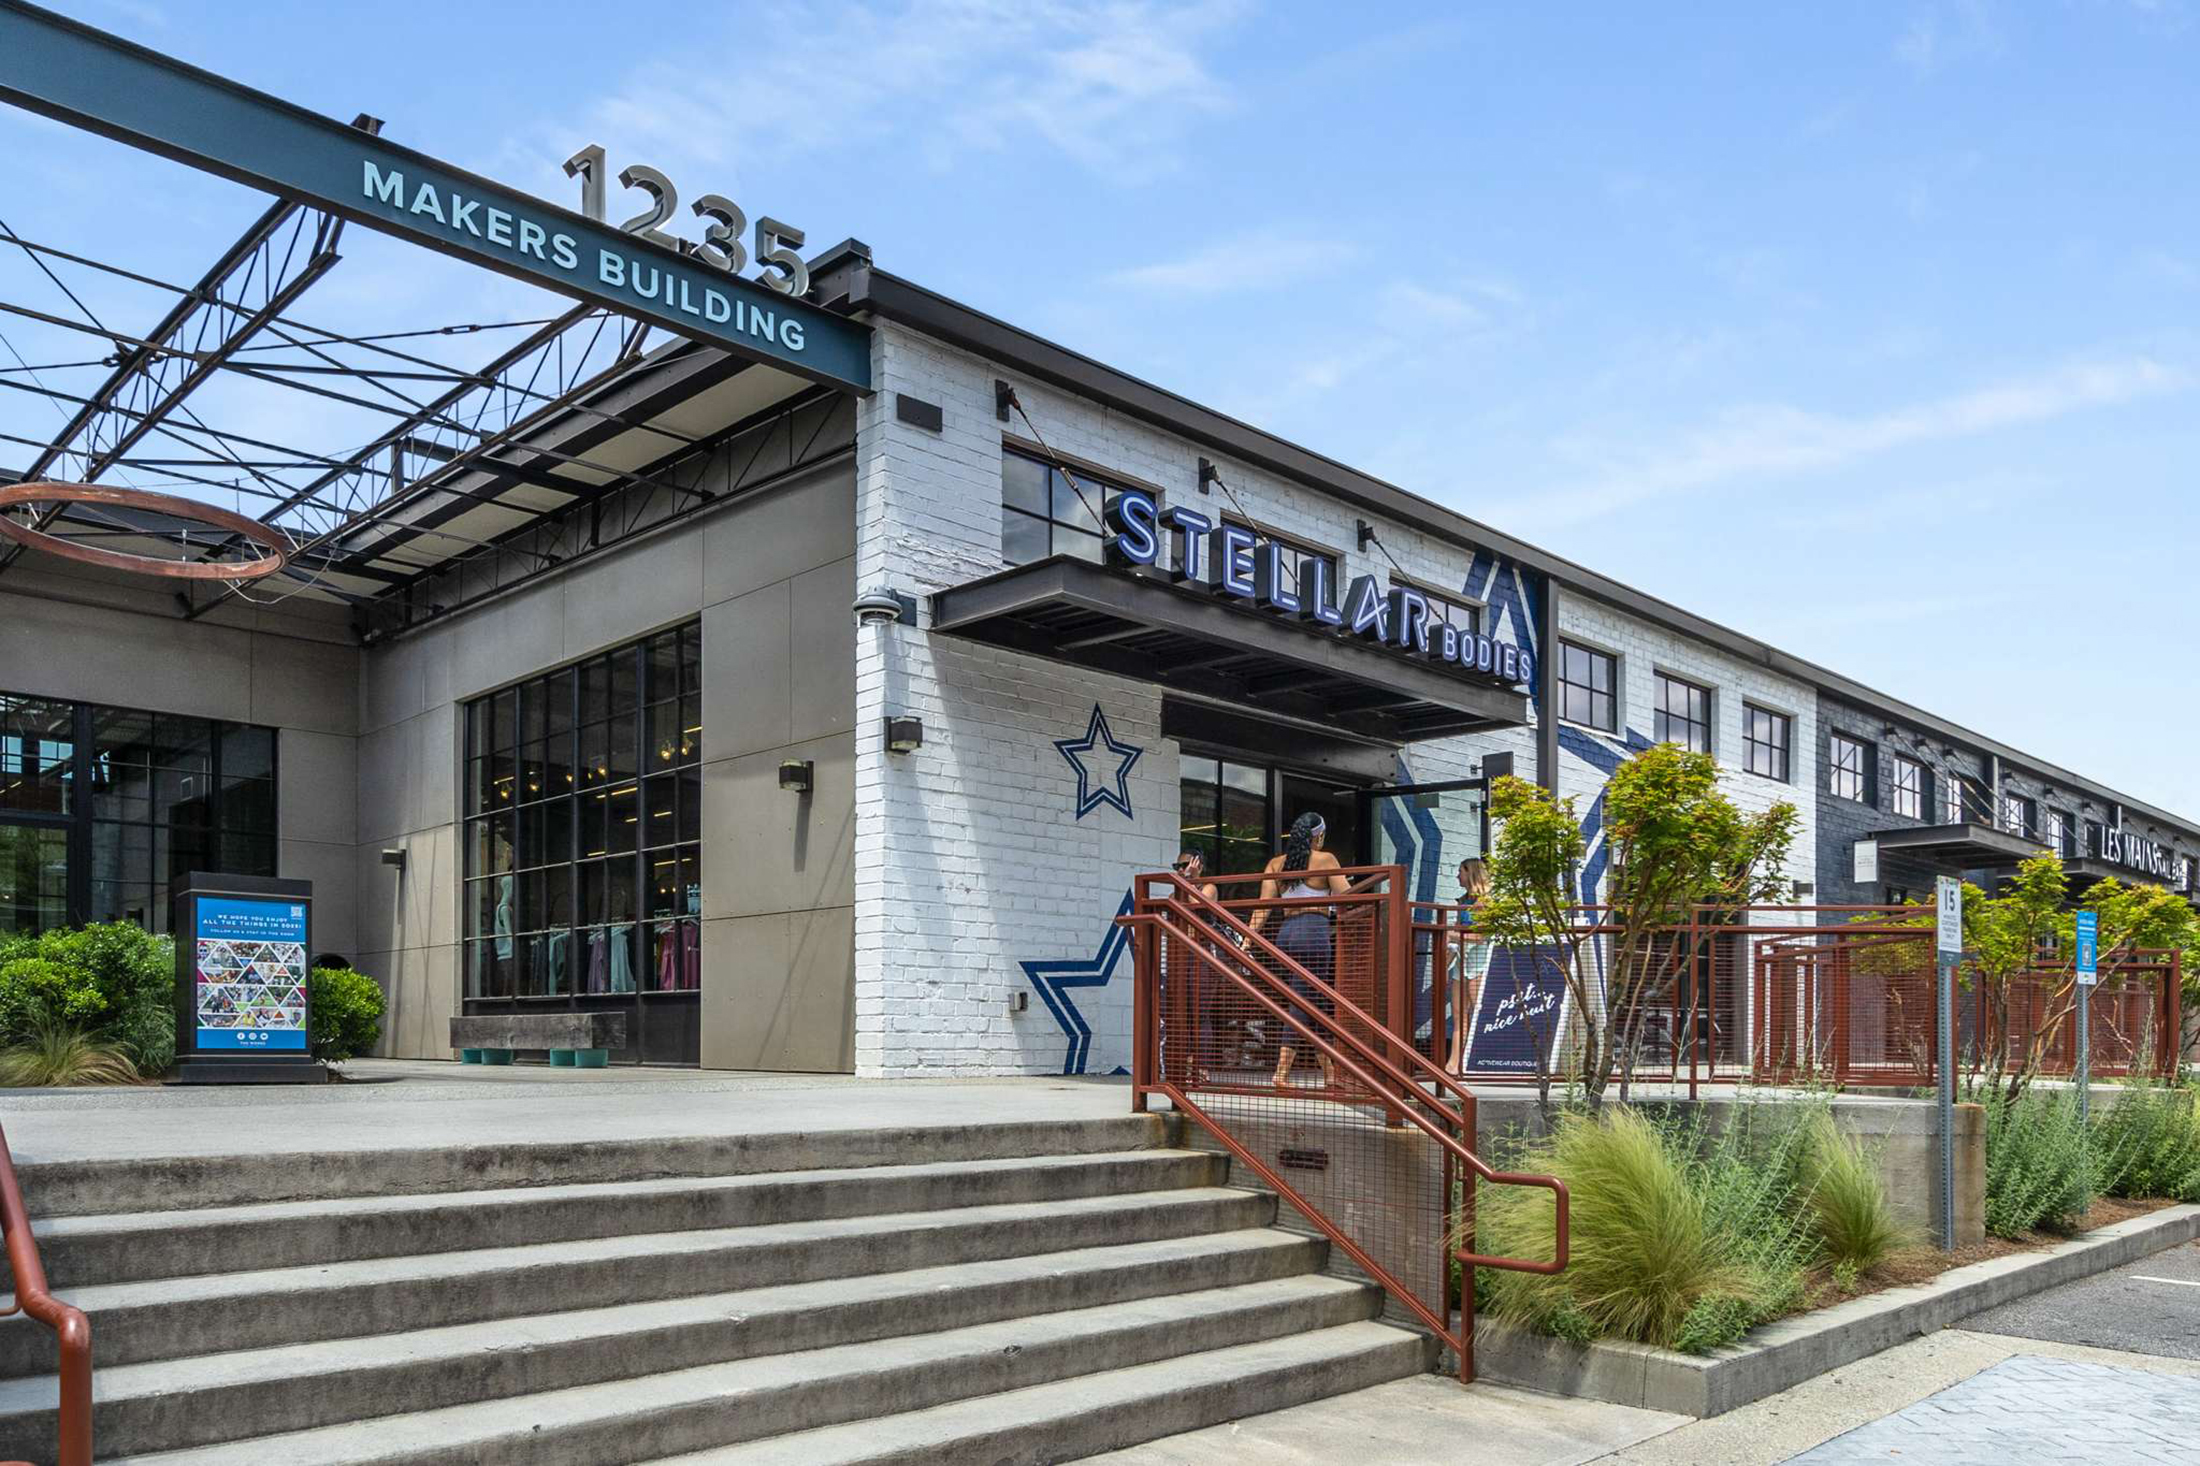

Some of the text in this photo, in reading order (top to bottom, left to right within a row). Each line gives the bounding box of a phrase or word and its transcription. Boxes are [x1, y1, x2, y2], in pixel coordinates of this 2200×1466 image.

[362, 160, 806, 352] MAKERS BUILDING
[562, 144, 810, 298] 1235
[1106, 489, 1534, 685] STELLAR BODIES
[1944, 889, 1955, 911] 15
[2101, 825, 2122, 863] LES
[2124, 833, 2158, 875] MAINS
[1483, 1015, 1518, 1034] nice
